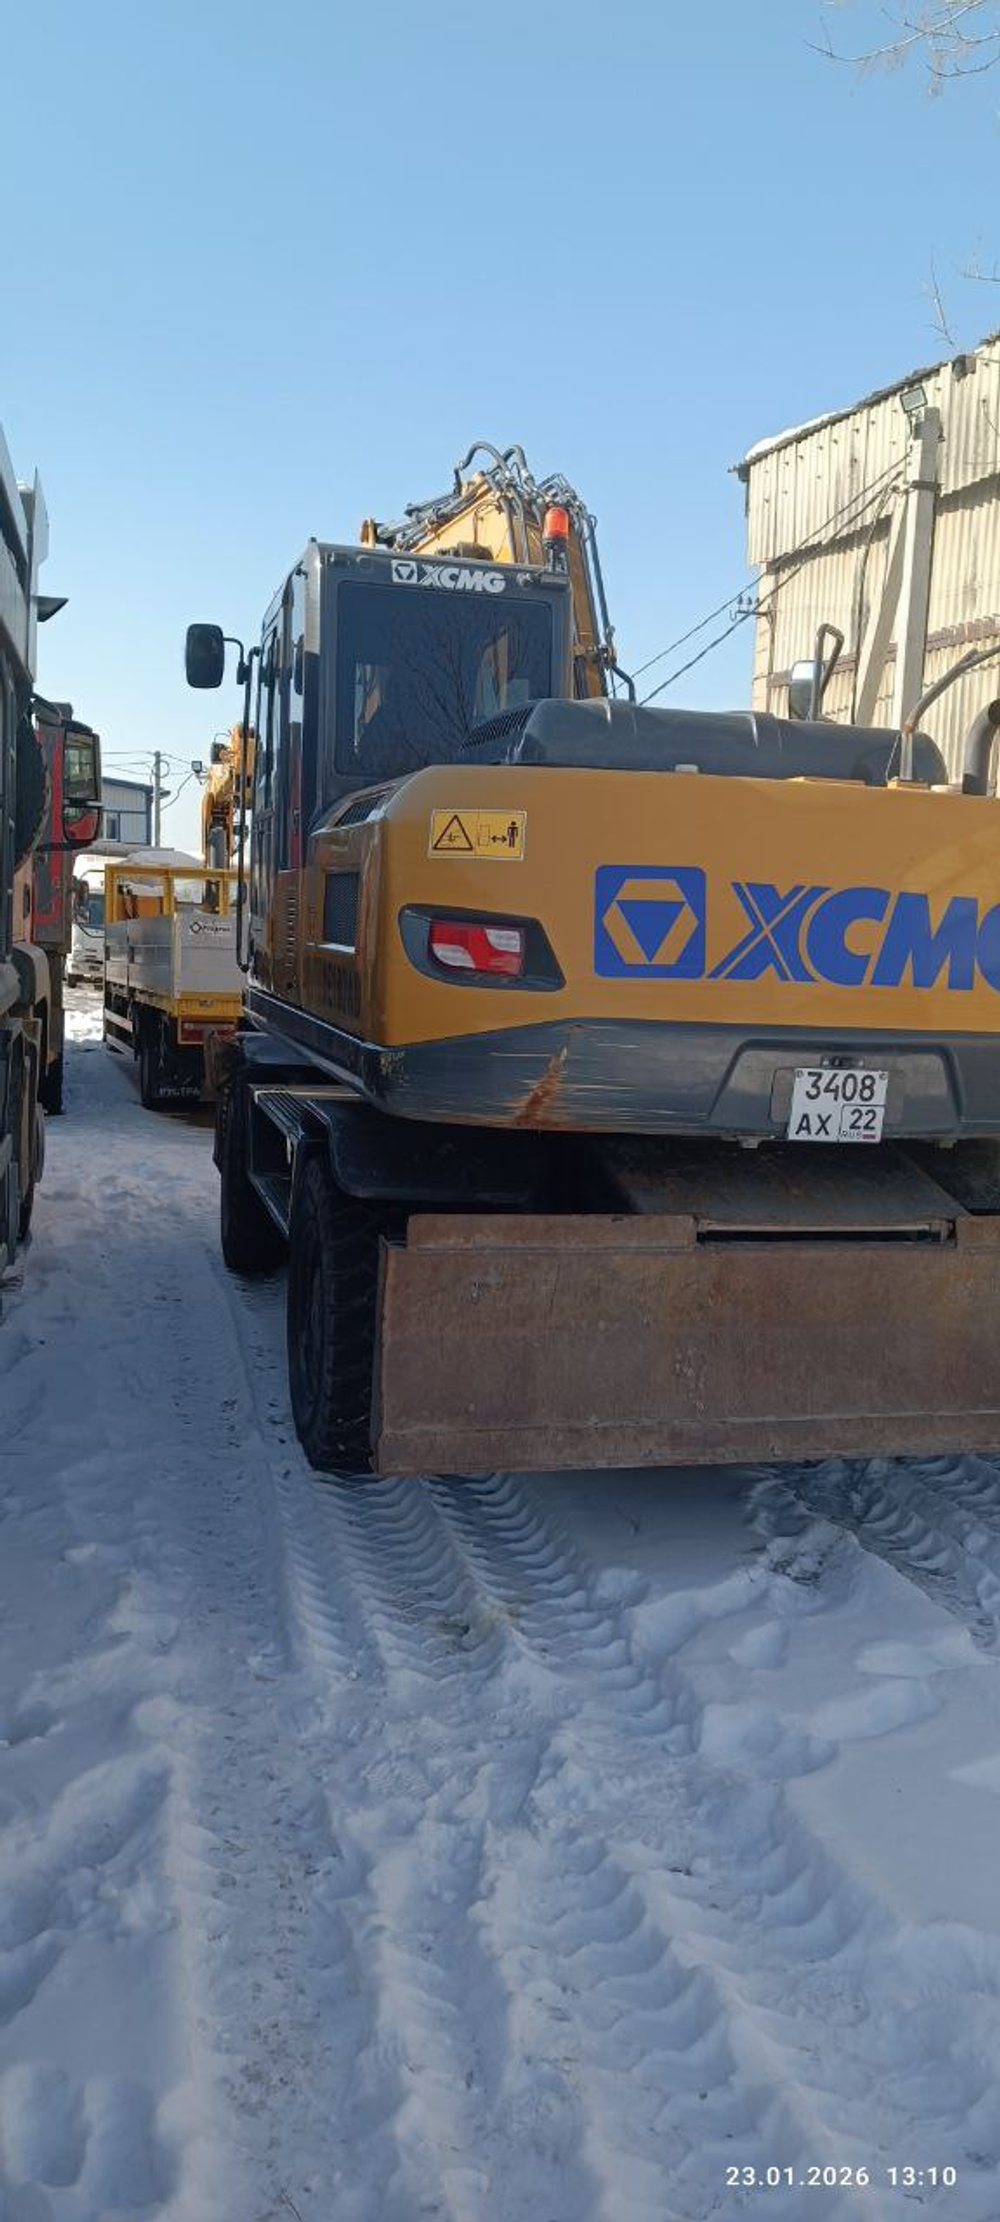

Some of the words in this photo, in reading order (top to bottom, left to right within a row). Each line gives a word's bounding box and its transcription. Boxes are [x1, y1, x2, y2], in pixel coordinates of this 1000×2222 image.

[419, 564, 506, 593] XCMG
[706, 882, 1000, 993] XCM
[806, 1071, 876, 1102] 3408
[849, 1108, 877, 1130] 22
